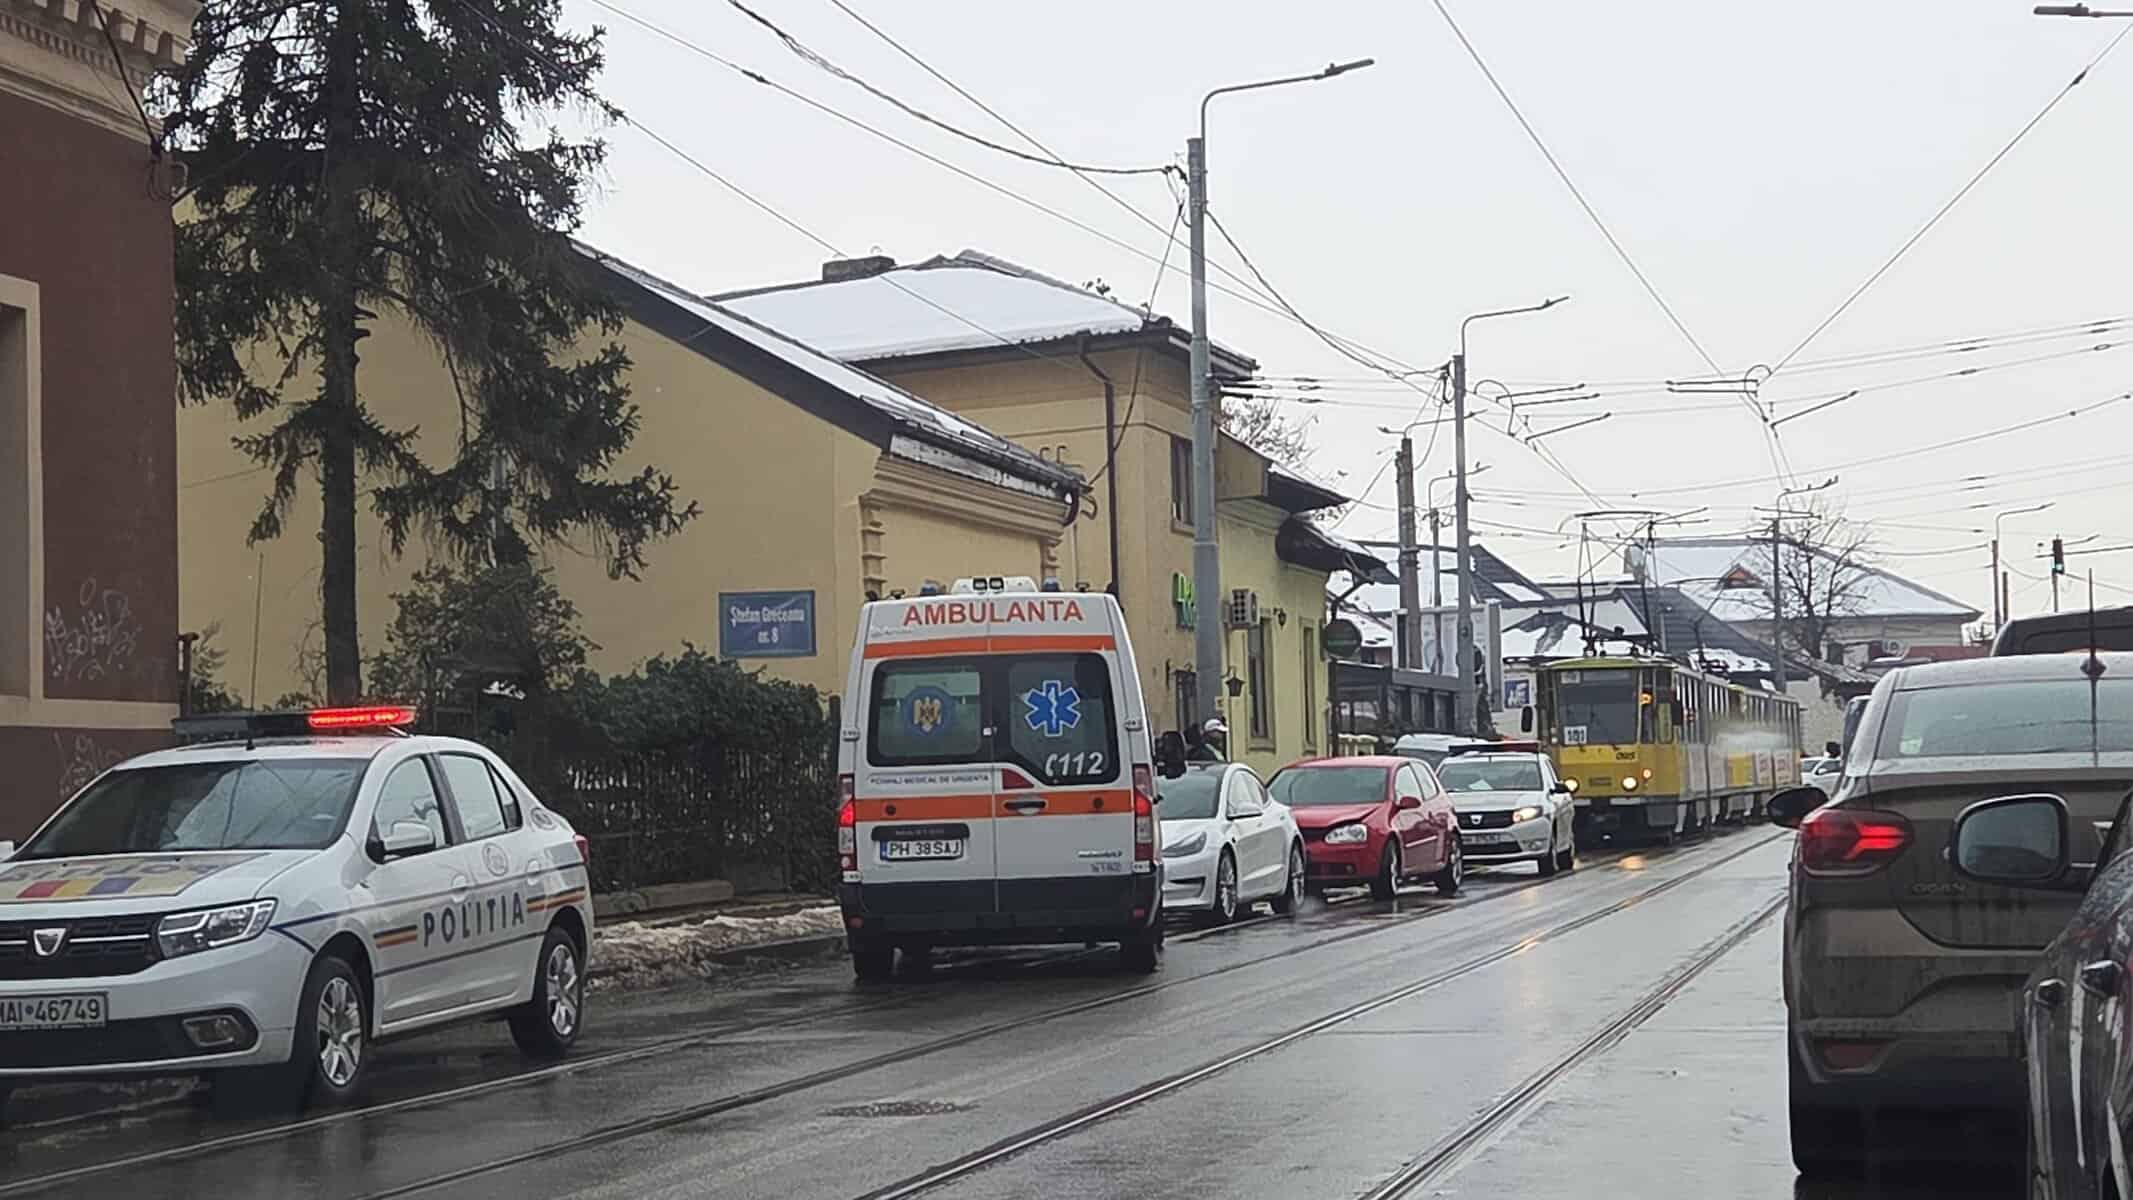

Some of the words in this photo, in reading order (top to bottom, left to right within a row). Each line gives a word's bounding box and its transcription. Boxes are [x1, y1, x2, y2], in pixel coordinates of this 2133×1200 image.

[903, 600, 1084, 626] AMBULANTA
[1058, 751, 1104, 777] 112
[889, 842, 910, 856] PH
[915, 841, 931, 856] 38
[933, 841, 960, 856] SAJ
[35, 998, 100, 1022] 46749
